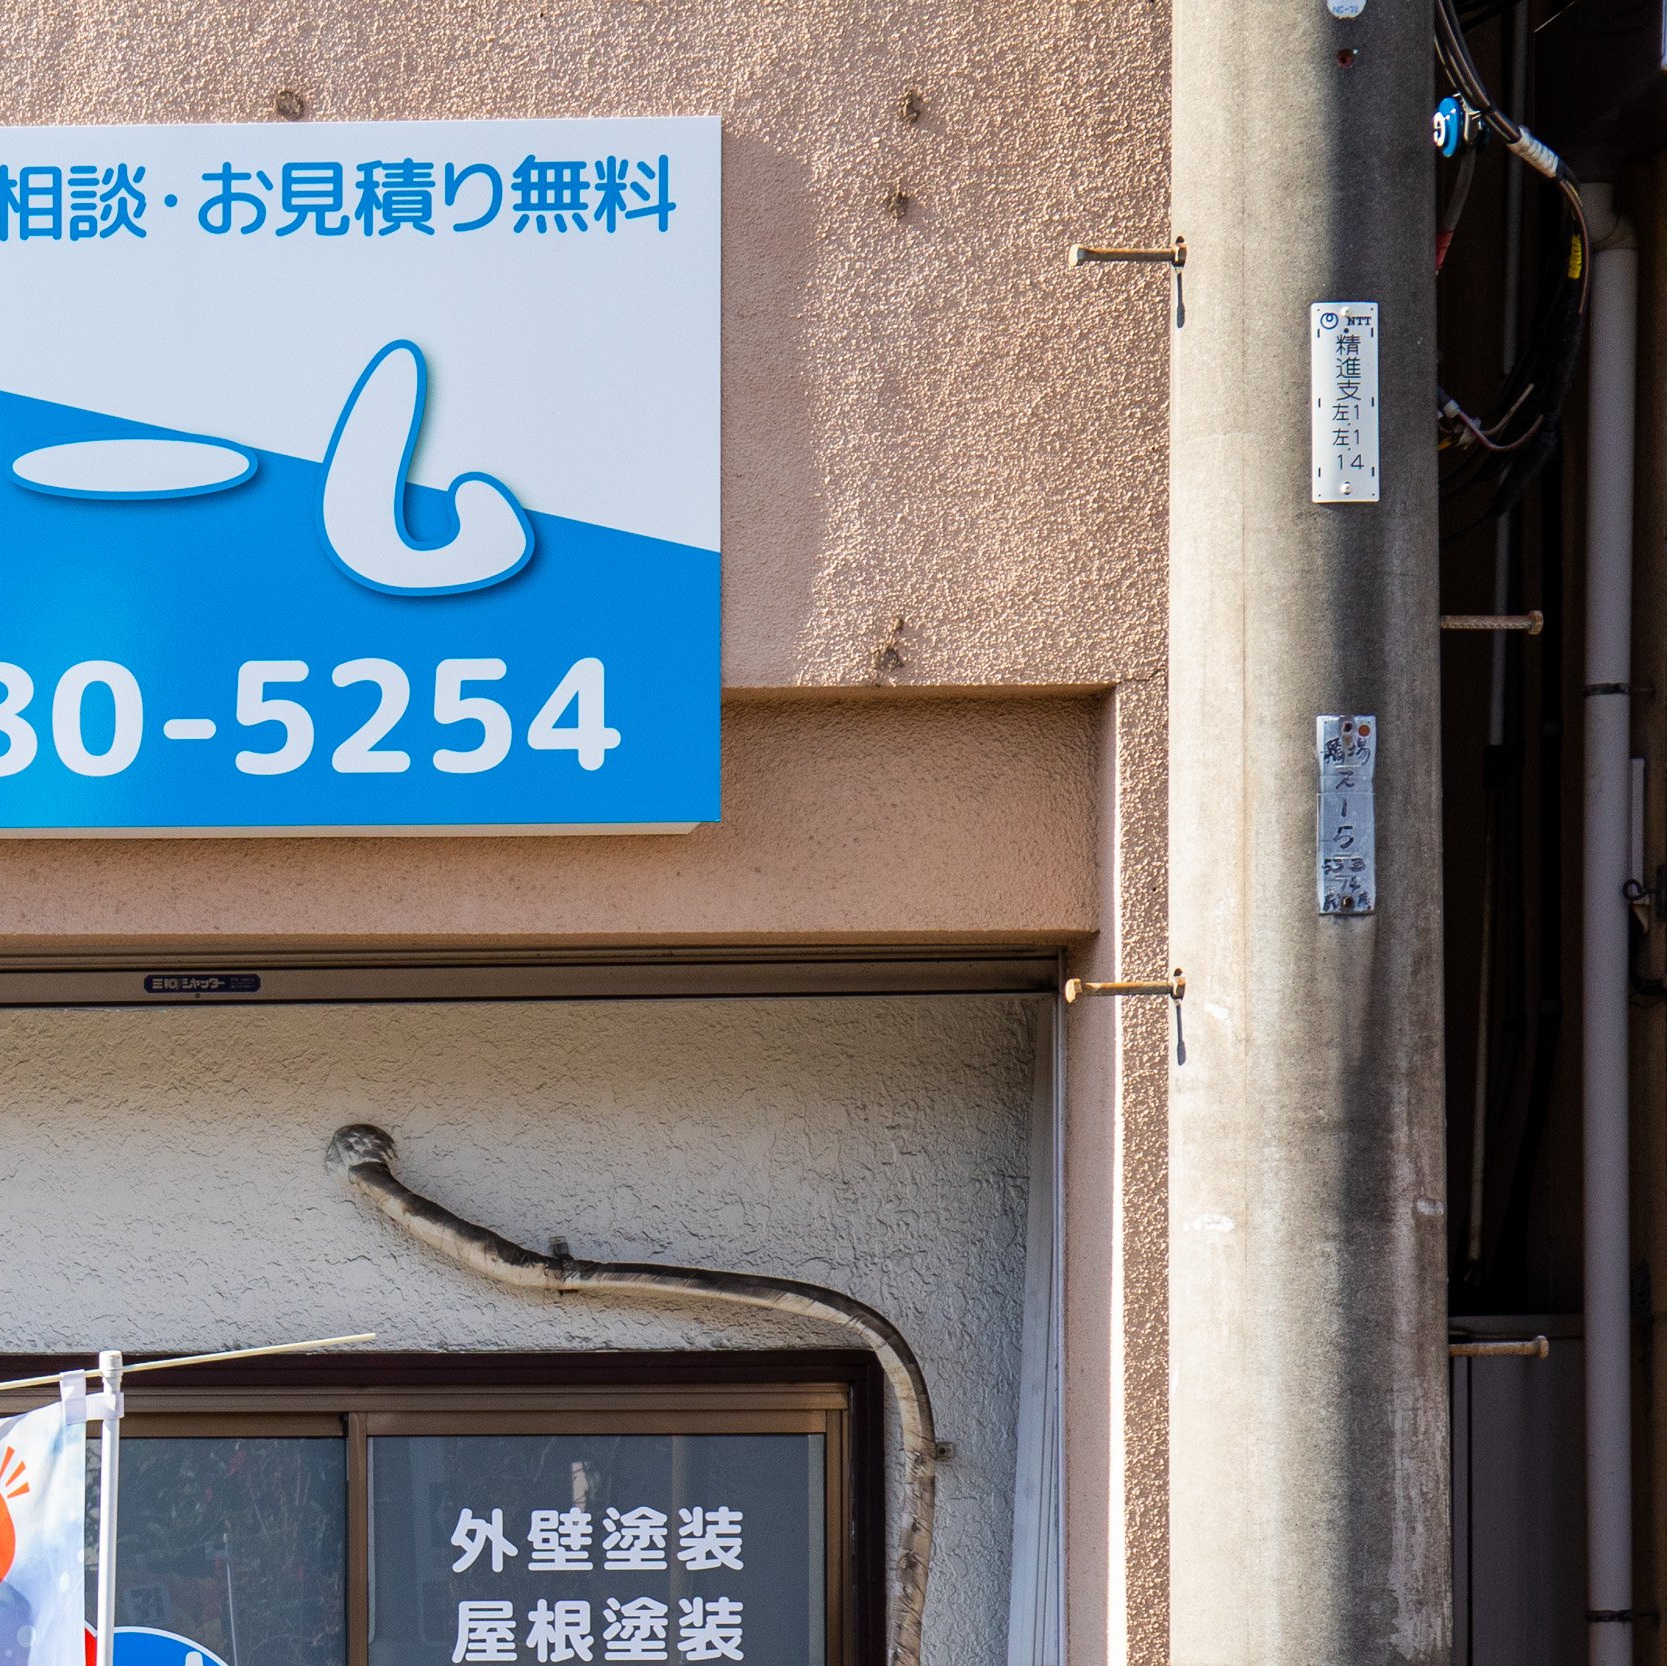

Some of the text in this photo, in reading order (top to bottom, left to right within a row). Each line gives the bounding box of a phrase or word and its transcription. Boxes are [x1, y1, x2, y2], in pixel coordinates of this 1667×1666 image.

[1347, 316, 1371, 326] NTT
[450, 1506, 745, 1573] 外壁塗装
[452, 1596, 745, 1662] 屋根塗装
